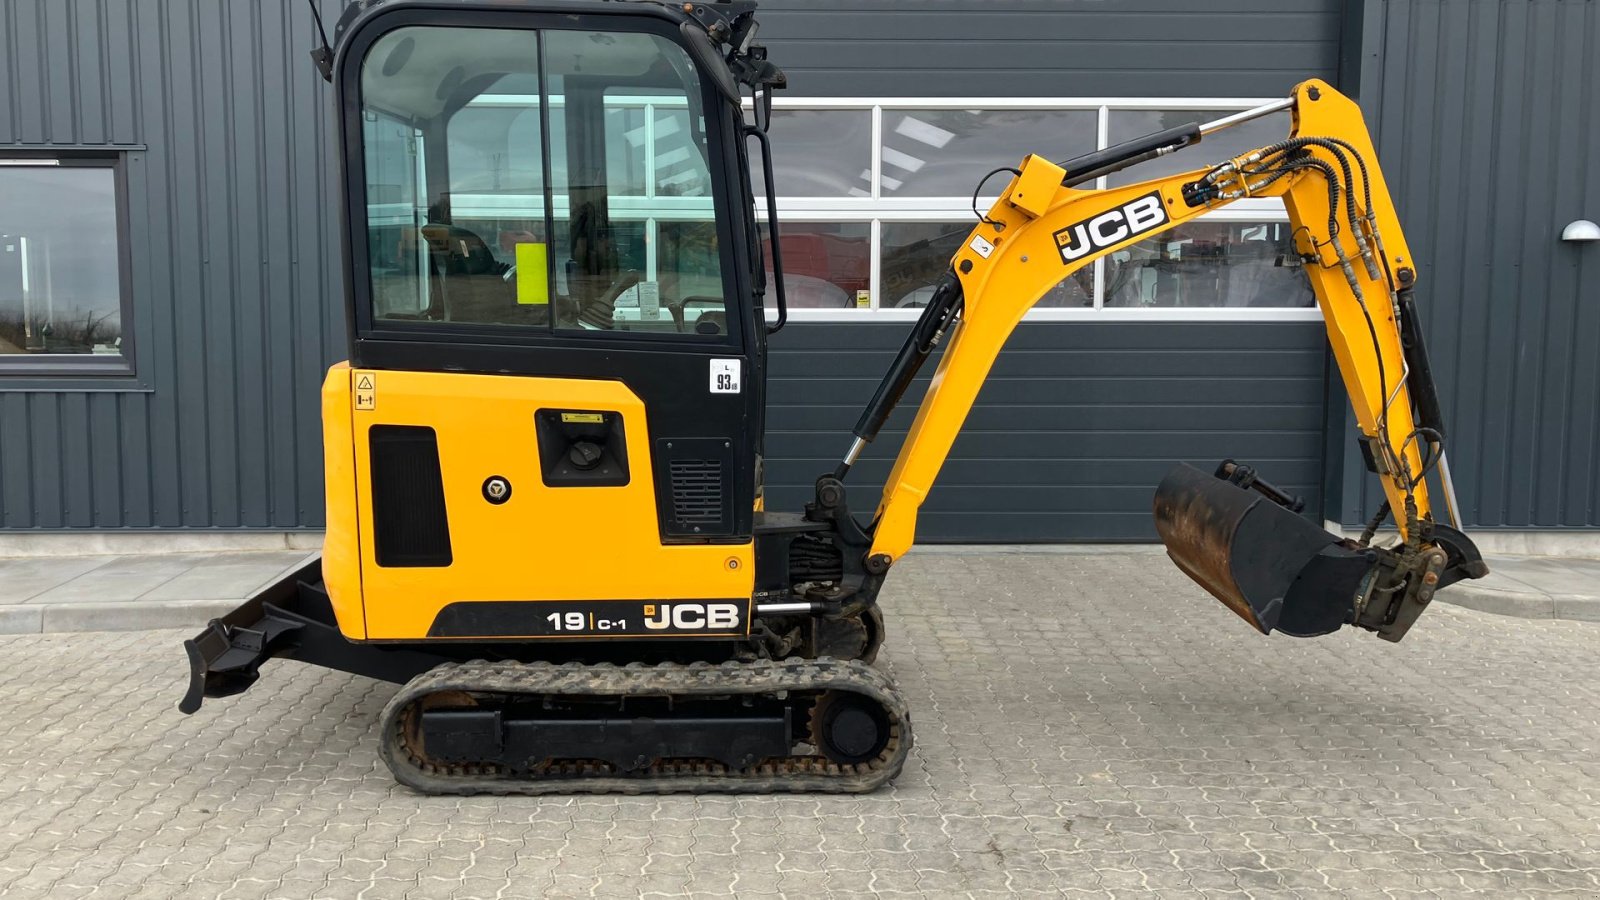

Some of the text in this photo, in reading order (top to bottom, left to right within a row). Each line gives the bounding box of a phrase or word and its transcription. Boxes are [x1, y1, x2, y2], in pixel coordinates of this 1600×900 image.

[1058, 196, 1165, 260] JCB
[717, 374, 731, 390] 93
[546, 612, 585, 631] 19
[644, 604, 740, 630] JCB
